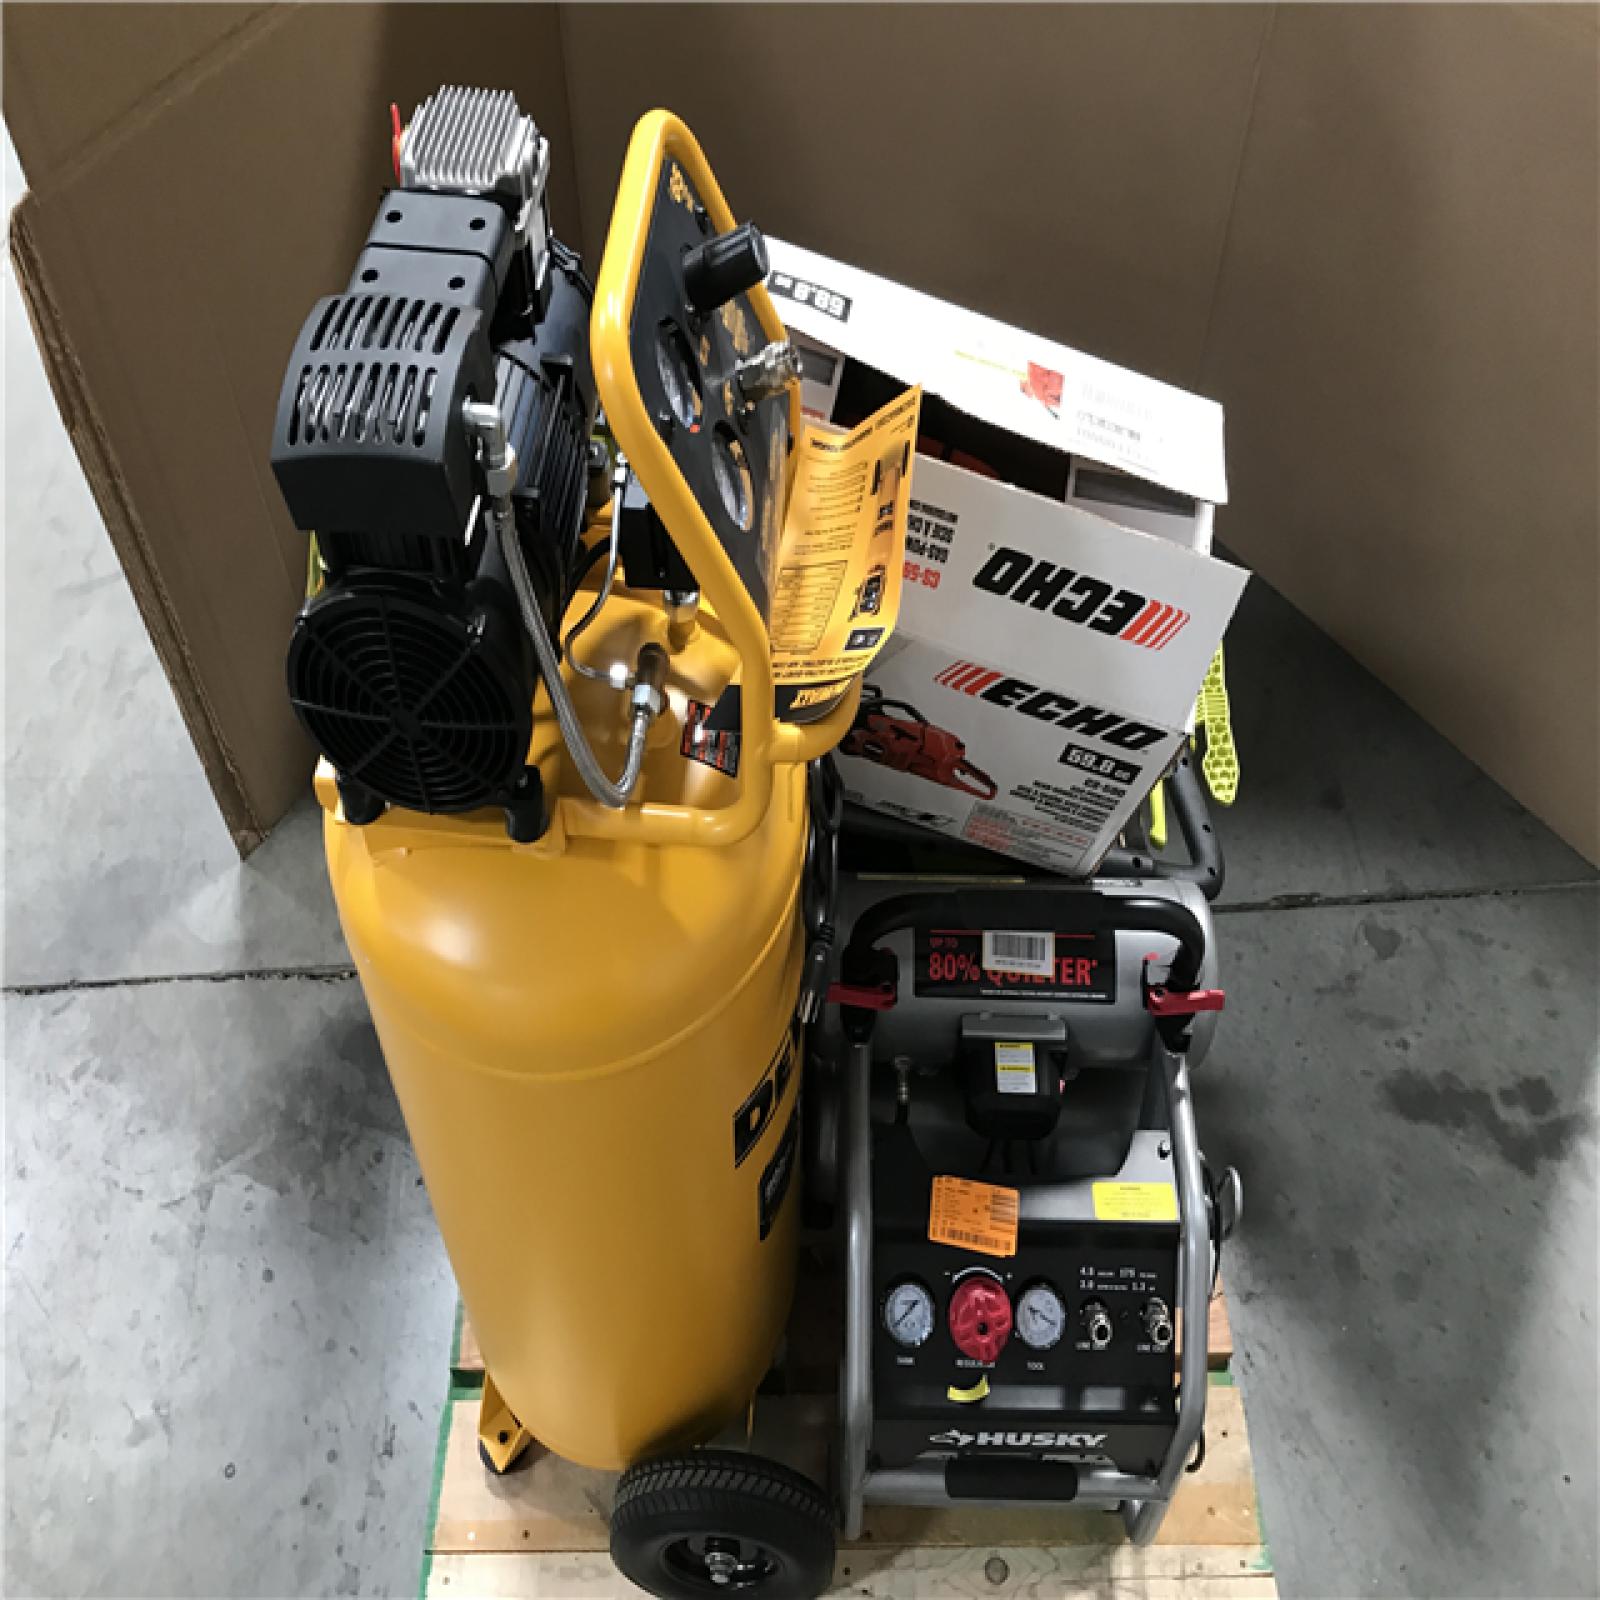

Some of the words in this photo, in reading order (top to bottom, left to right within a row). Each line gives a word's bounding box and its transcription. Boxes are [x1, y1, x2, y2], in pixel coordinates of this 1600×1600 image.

[972, 546, 1148, 636] ECHO
[980, 677, 1169, 751] ECHO
[929, 952, 981, 981] 80%
[975, 1431, 1108, 1448] HUSKY
